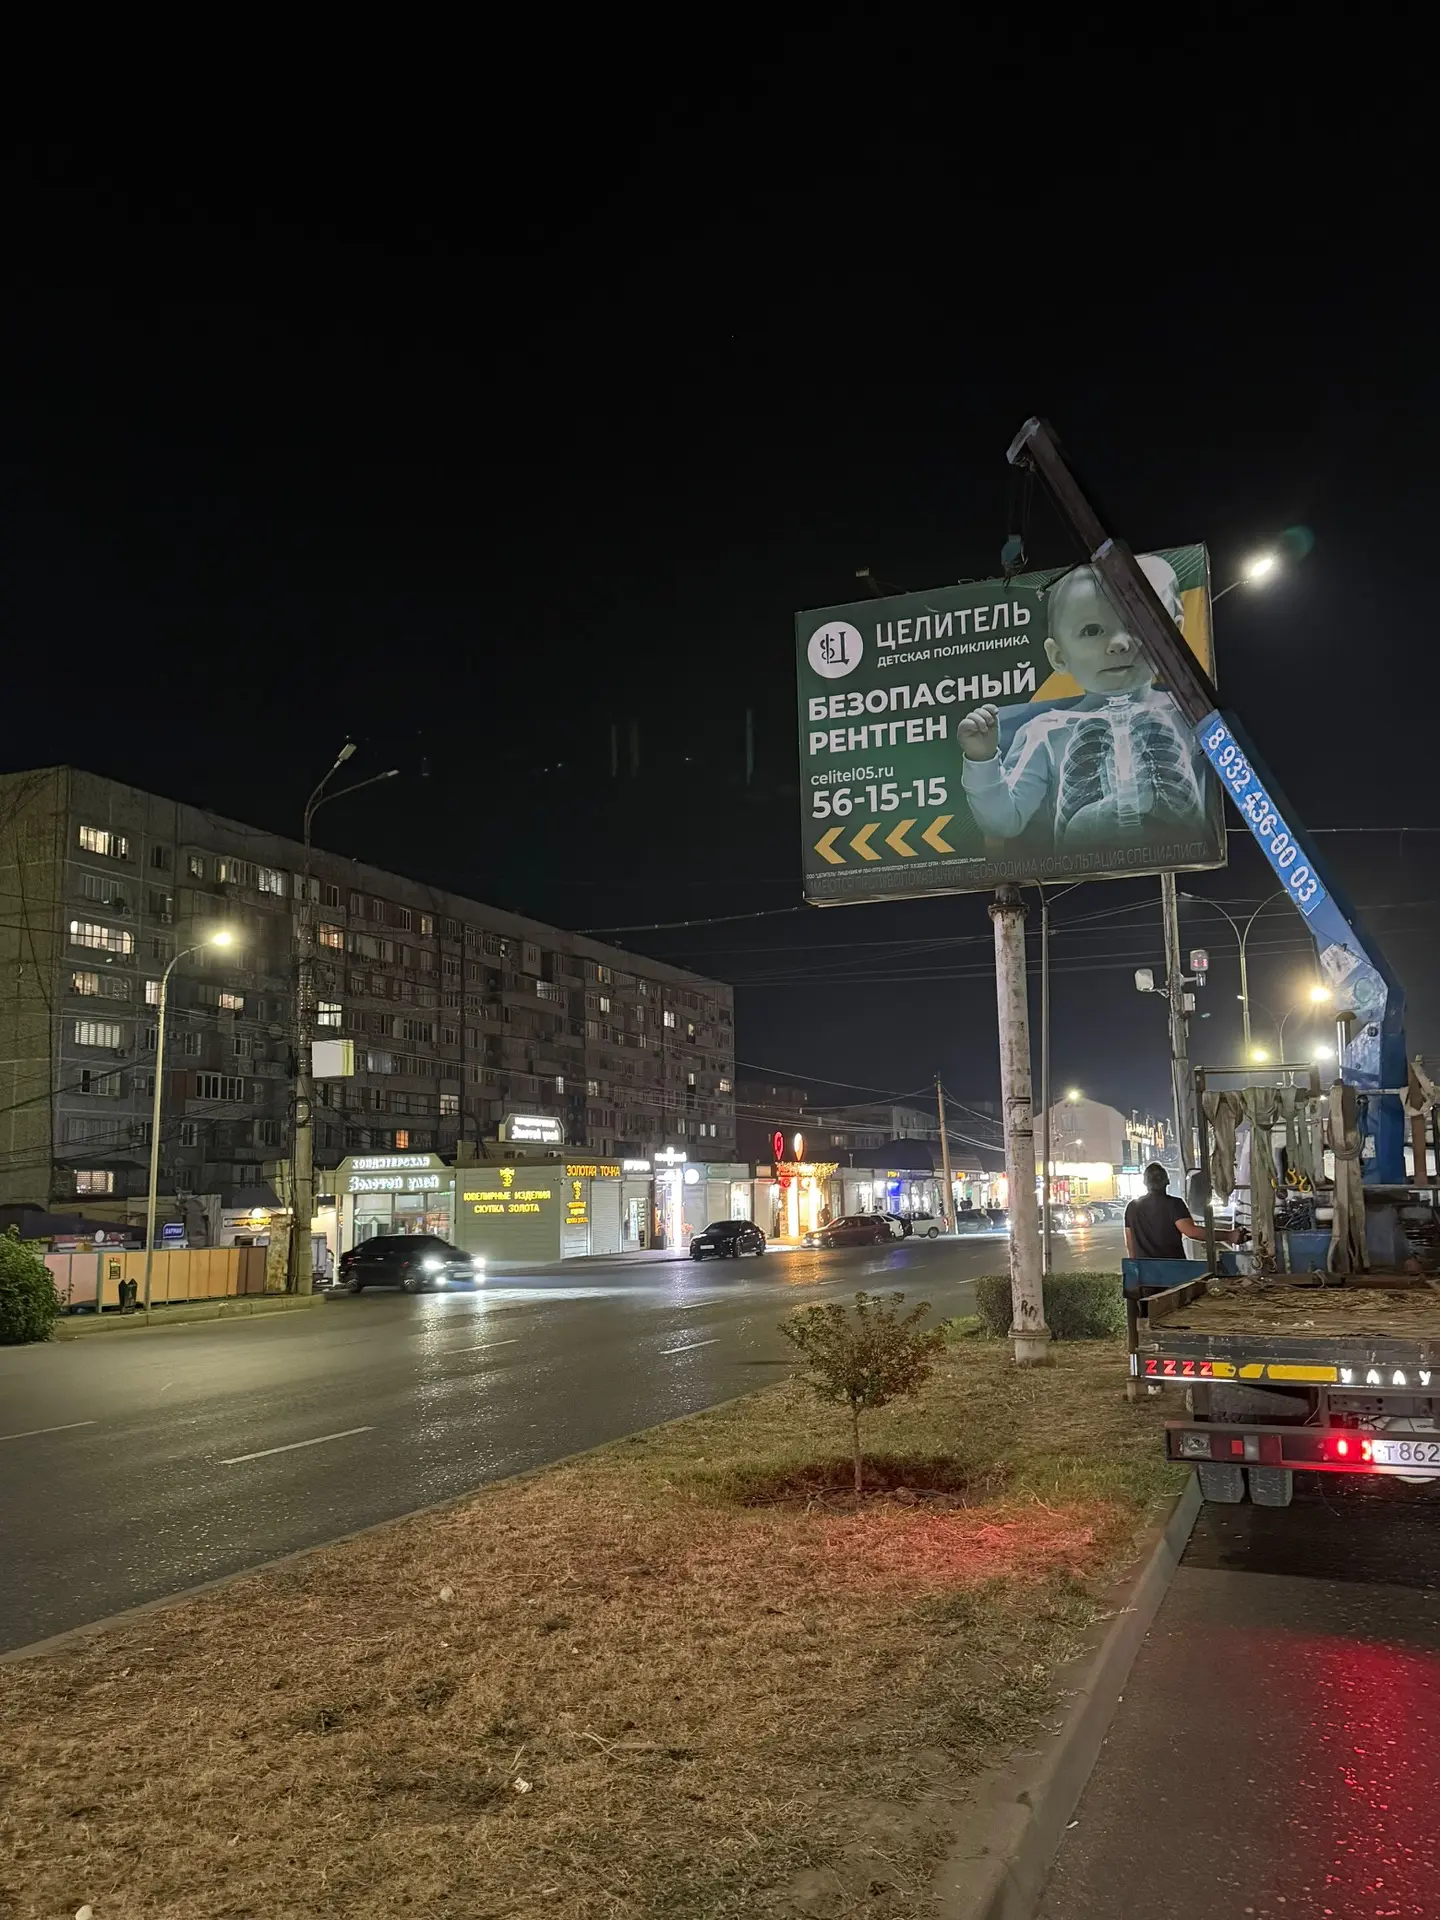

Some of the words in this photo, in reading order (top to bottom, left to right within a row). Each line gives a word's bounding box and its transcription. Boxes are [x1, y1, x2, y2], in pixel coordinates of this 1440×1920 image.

[876, 601, 1031, 651] ЦЕЛИТЕЛЬ
[877, 649, 931, 668] ДЕТСКАЯ
[934, 634, 1030, 659] ПОЛИКЛИНИКА
[808, 661, 1037, 721] БЕЗОПАСНЫЙ
[809, 715, 948, 756] РЕНТГЕН
[810, 765, 894, 786] celitel05.ru
[811, 776, 948, 819] 56-15-15
[1208, 727, 1226, 750] 8
[1219, 745, 1251, 793] 932
[1290, 865, 1317, 901] 03
[1041, 850, 1124, 873] КОНСУЛЬТАЦИЯ
[566, 1164, 597, 1177] ЗОЛОТАЯ
[600, 1165, 621, 1177] ТОЧКА
[463, 1191, 512, 1202] ЮВЕЛИРНЫЕ
[514, 1190, 552, 1202] ИЗДЕЛИЯ
[474, 1204, 505, 1214] СКУПКА
[508, 1203, 540, 1213] ЗОЛОТА
